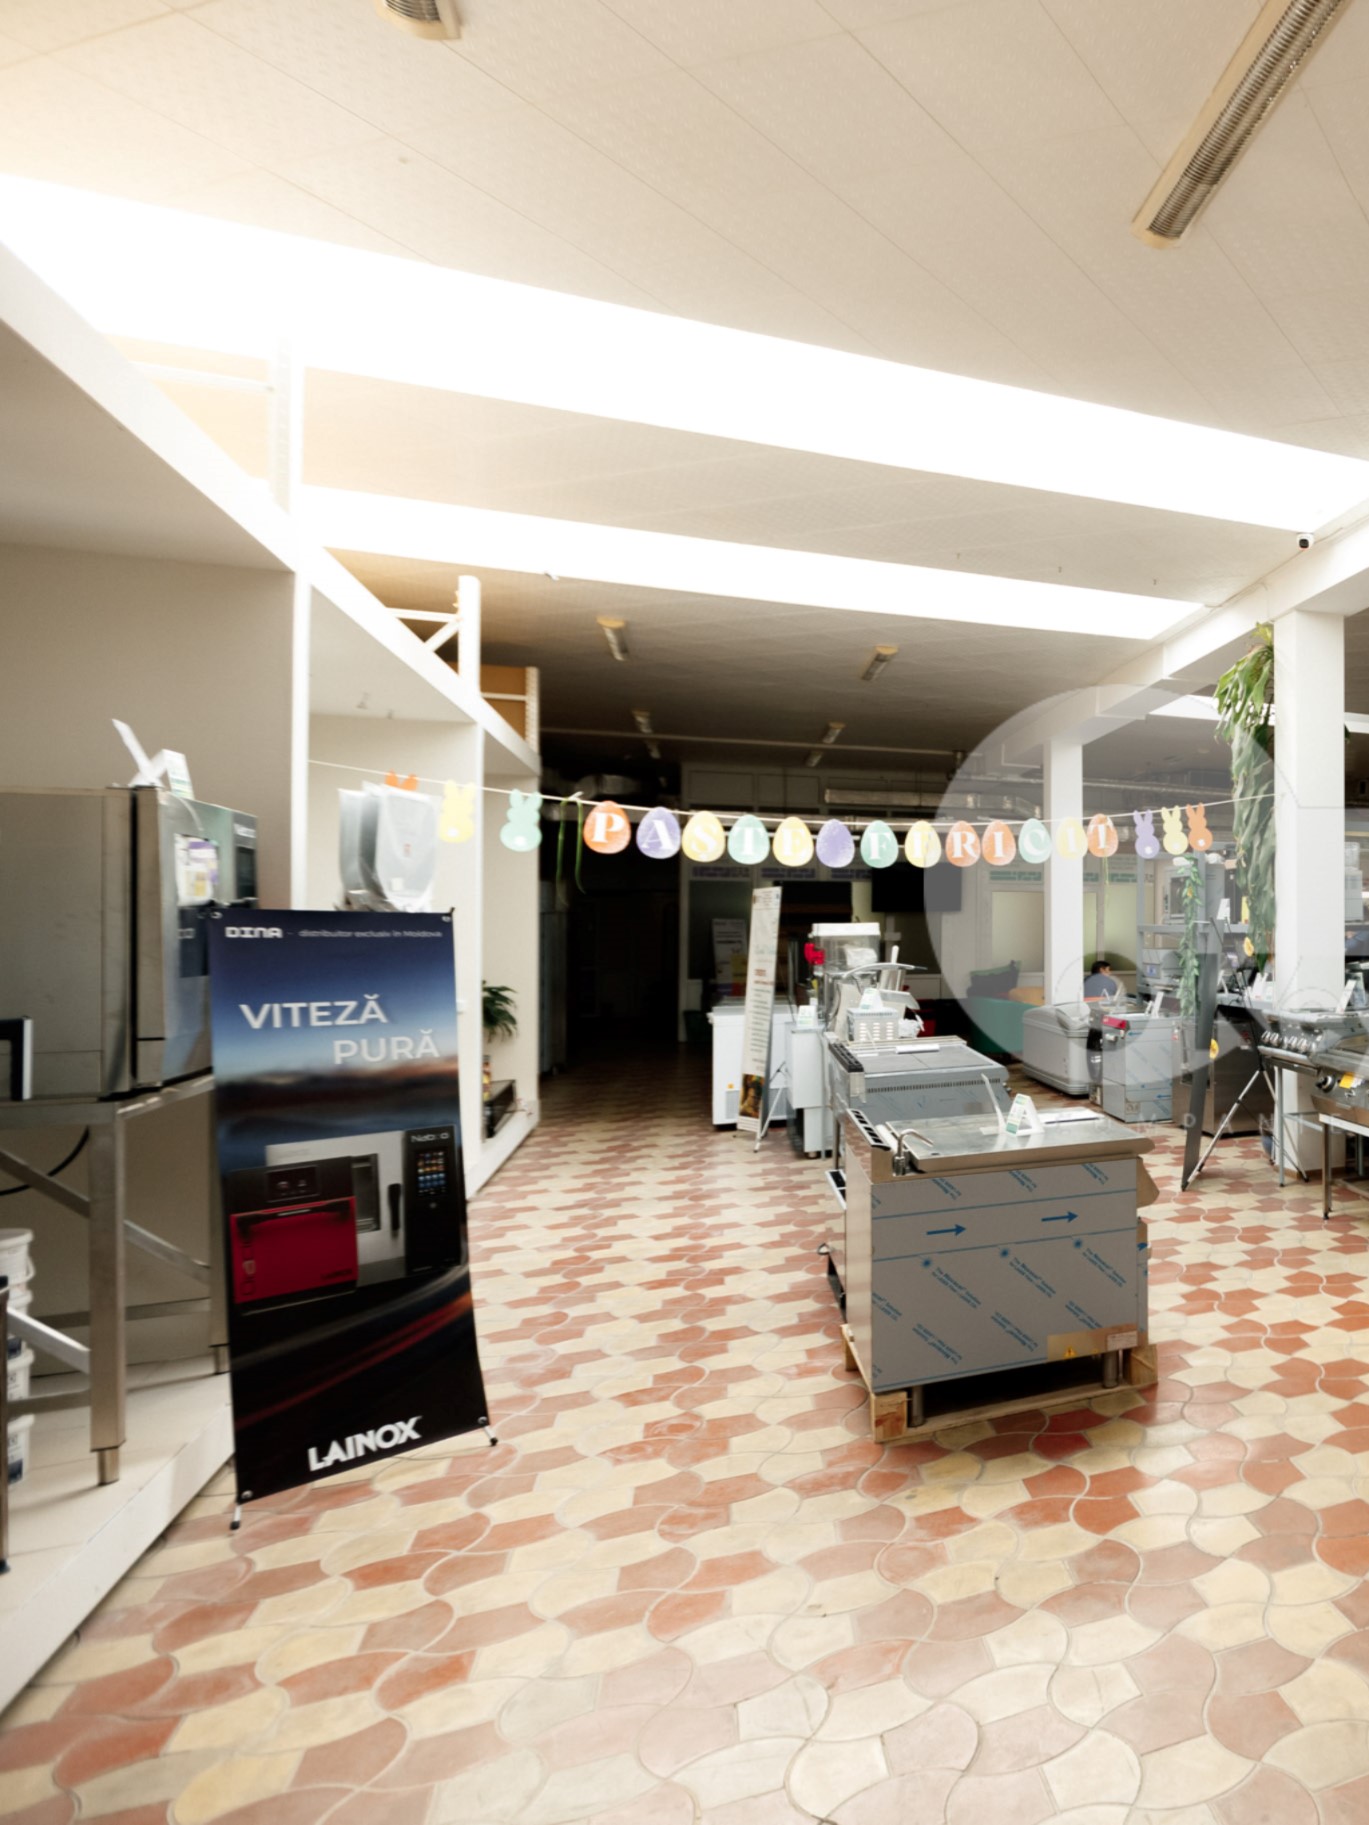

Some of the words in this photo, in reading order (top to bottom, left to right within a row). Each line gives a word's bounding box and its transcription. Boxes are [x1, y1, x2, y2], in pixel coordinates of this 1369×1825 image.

[225, 926, 283, 939] DINA
[239, 993, 388, 1029] VITEZĂ
[333, 1029, 440, 1065] PURĂ
[308, 1415, 423, 1472] LAINOX
